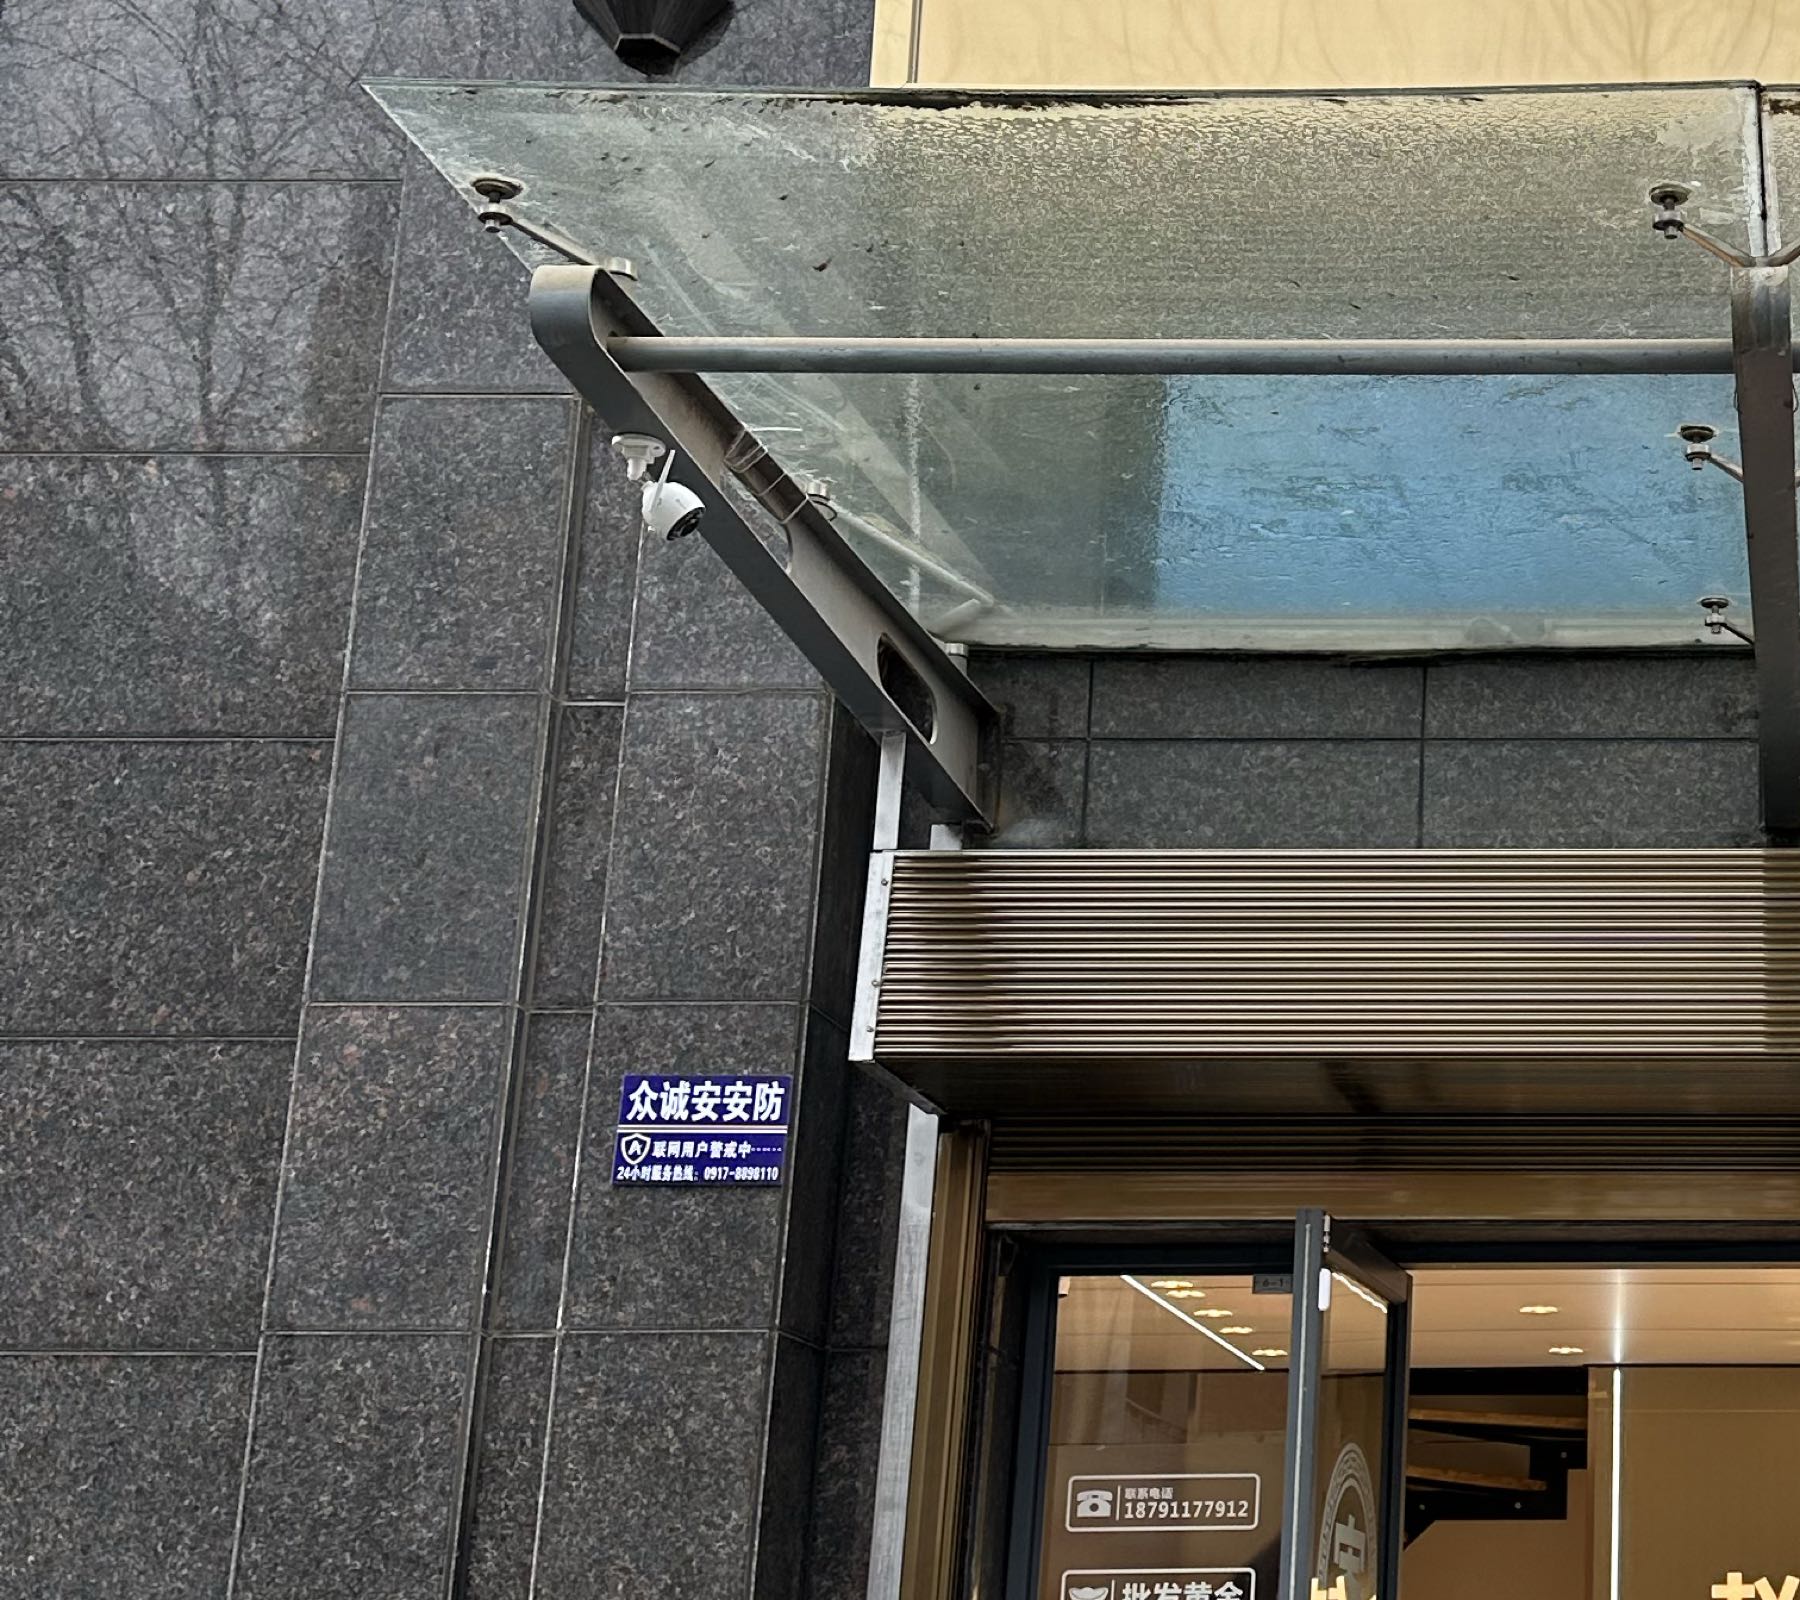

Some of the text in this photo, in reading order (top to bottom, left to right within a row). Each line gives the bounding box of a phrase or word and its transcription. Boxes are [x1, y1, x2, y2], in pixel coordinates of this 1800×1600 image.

[625, 1079, 786, 1122] 众诚安安防
[1124, 1500, 1249, 1519] 18791177912
